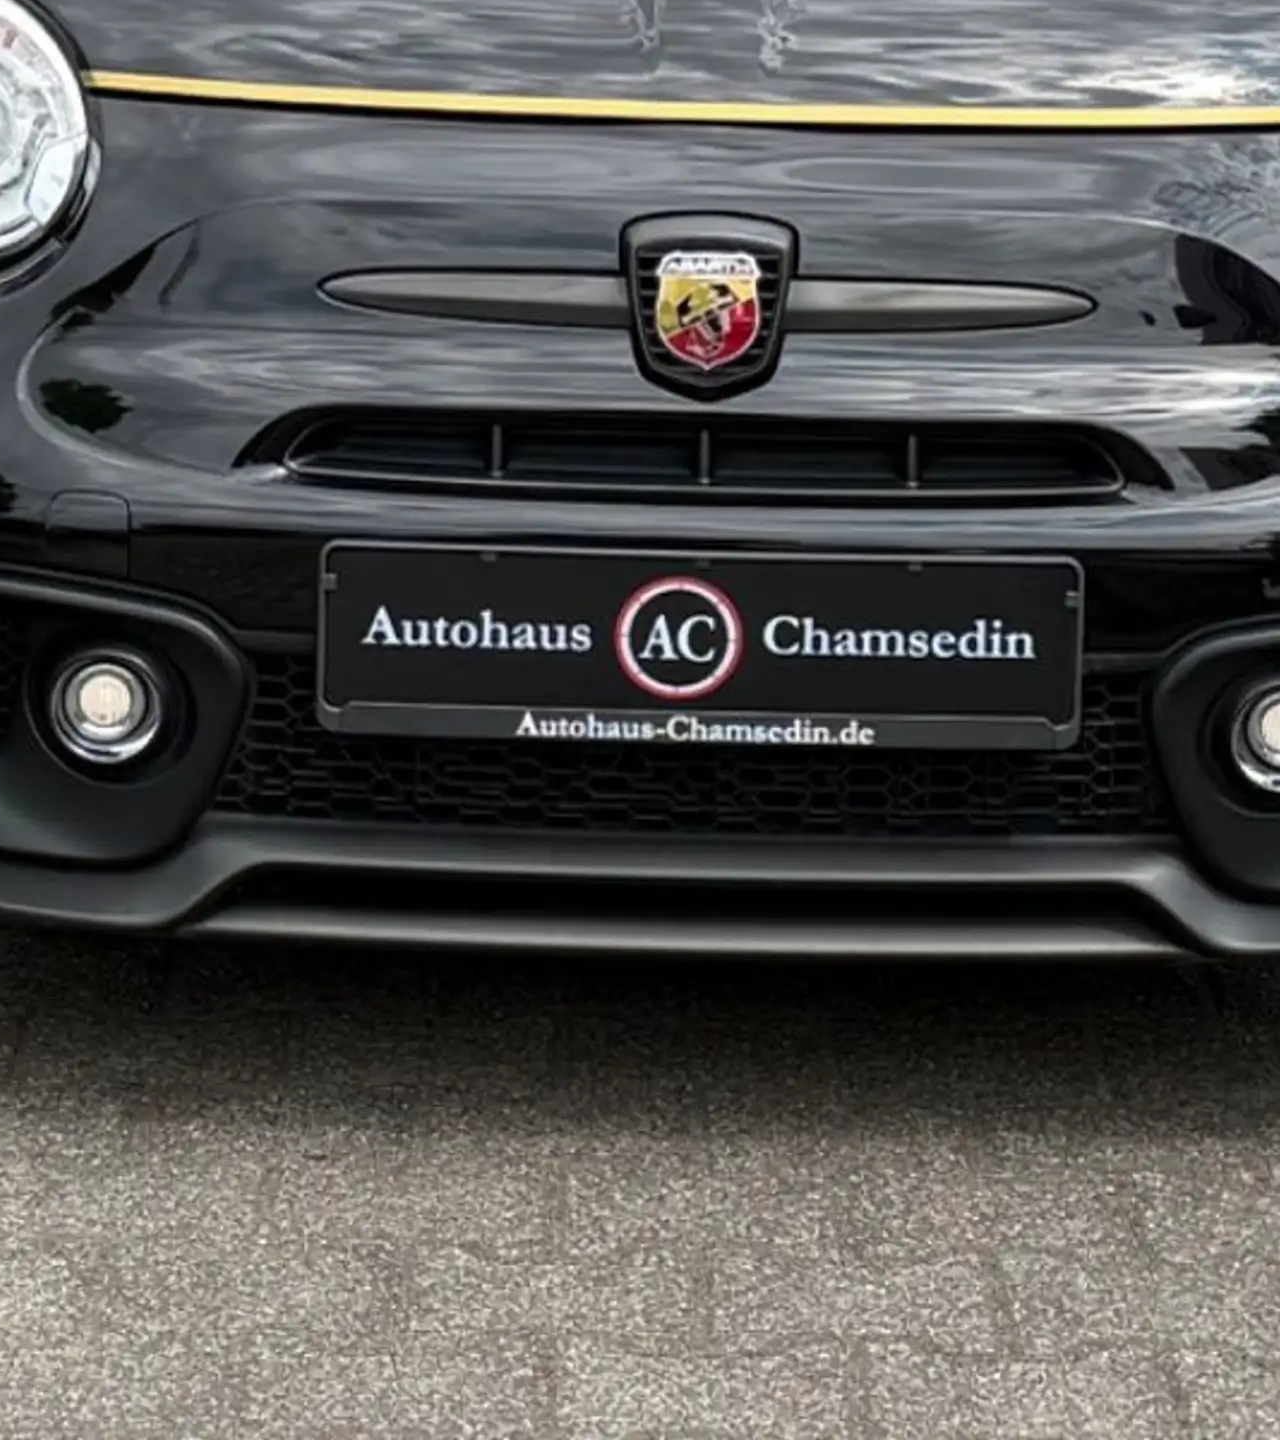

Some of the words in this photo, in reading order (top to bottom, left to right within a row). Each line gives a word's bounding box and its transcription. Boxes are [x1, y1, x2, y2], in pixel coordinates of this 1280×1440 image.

[362, 605, 592, 652] Autohaus
[639, 615, 715, 663] AC
[762, 615, 1036, 659] Chamsedin
[515, 710, 875, 745] Autohaus-Chamsedin.de
